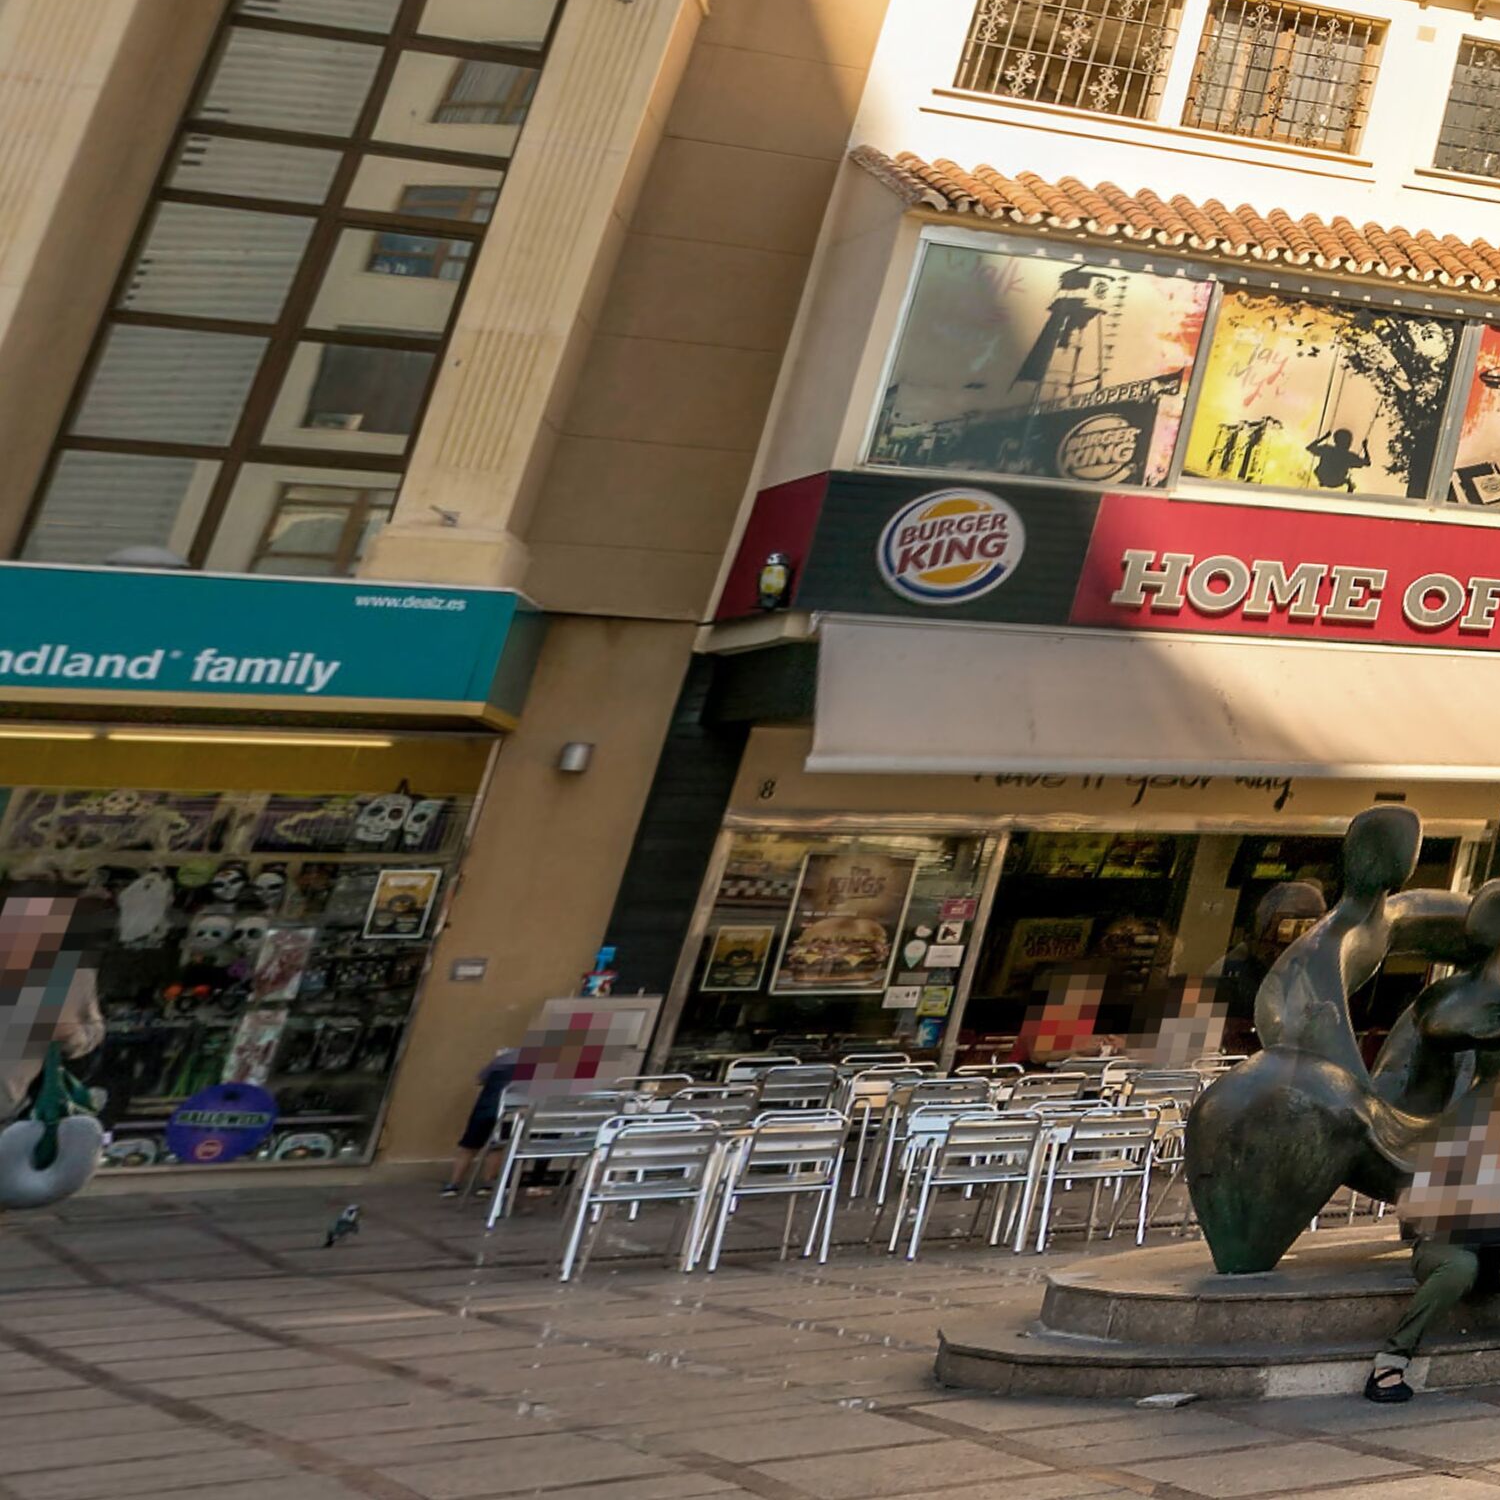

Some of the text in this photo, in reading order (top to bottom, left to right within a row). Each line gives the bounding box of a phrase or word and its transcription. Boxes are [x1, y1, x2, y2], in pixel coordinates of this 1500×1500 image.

[1069, 426, 1141, 449] BURGER
[1066, 441, 1137, 467] KING
[900, 512, 1009, 547] BURGER
[896, 537, 1011, 575] KING
[1110, 547, 1388, 621] HOME
[354, 593, 467, 612] www.dealz.es
[190, 647, 341, 693] family
[760, 779, 776, 800] 8
